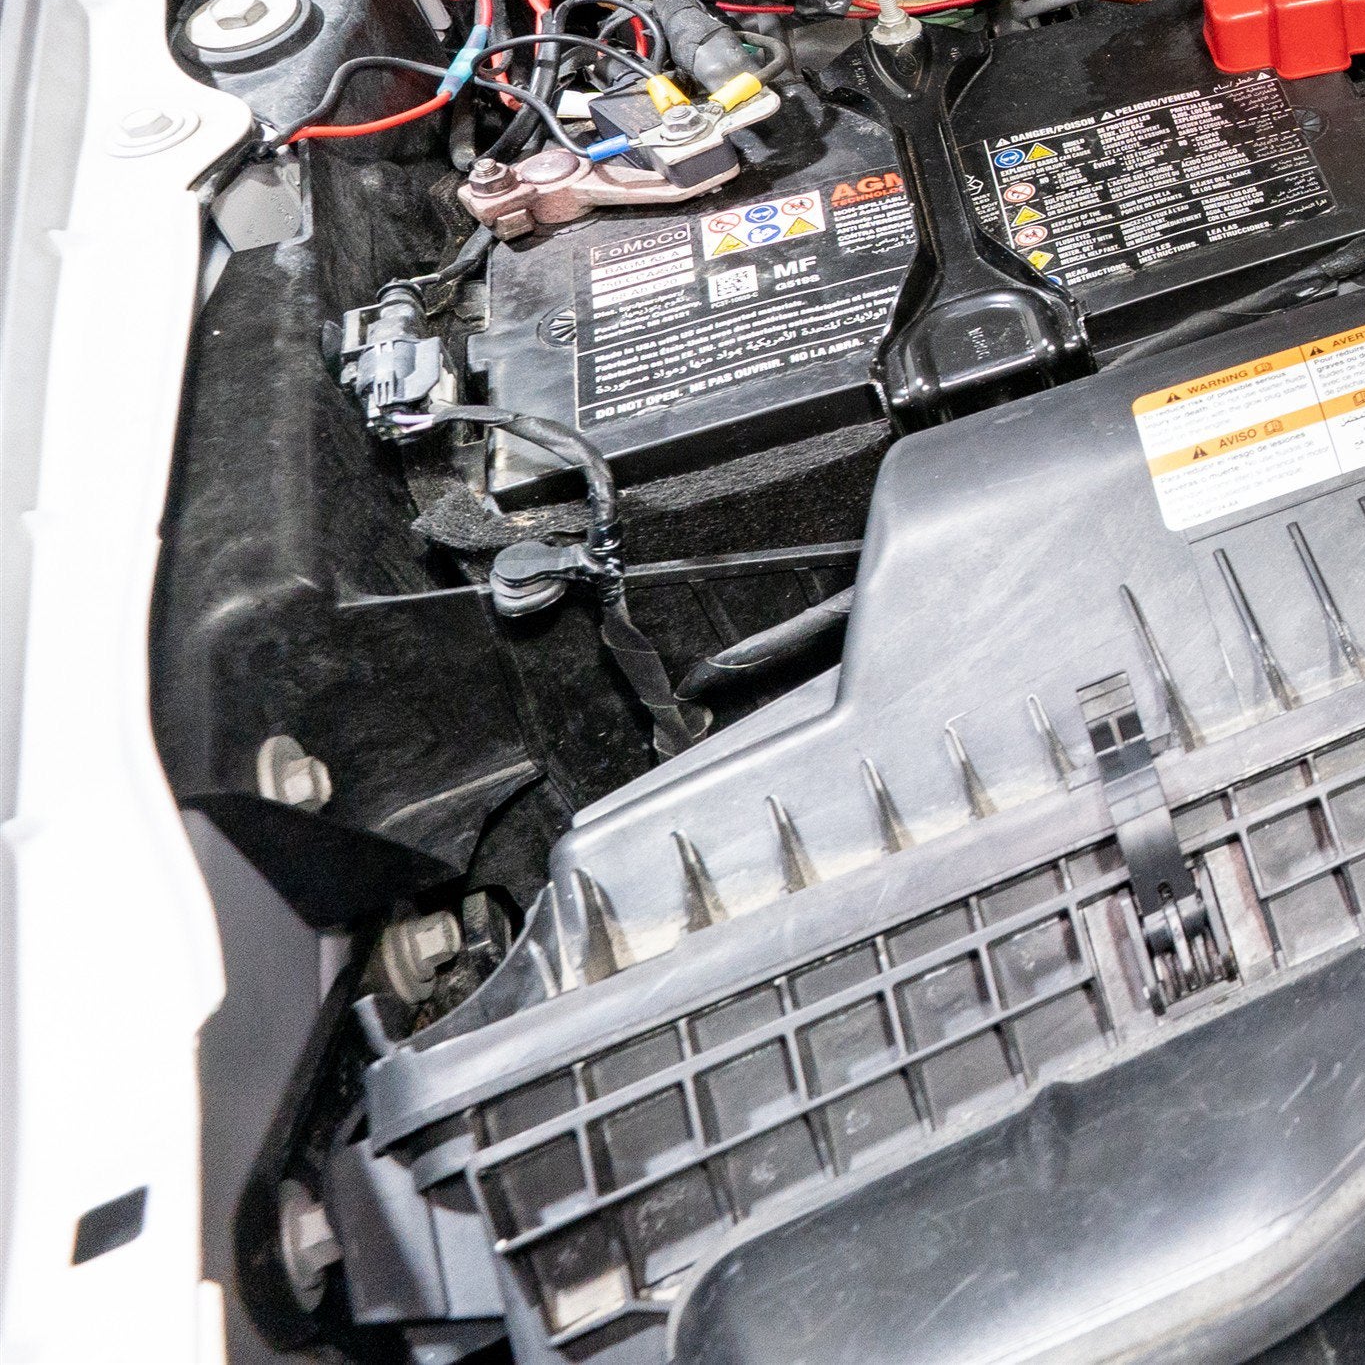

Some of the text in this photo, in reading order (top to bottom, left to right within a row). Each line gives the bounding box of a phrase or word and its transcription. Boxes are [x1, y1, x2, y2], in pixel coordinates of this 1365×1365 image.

[1010, 116, 1095, 144] DANGER/POISON
[1114, 89, 1200, 116] PELIGRO/VENENO
[1205, 223, 1238, 236] LEA LAS
[594, 226, 686, 262] FoMoCo
[773, 255, 818, 281] MF
[1064, 266, 1088, 278] READ
[594, 349, 622, 363] Made
[635, 339, 656, 352] USA
[595, 335, 864, 420] DO NOT OPEN. NE PAS OUVRIR. NO LA ABRA.
[1186, 368, 1248, 396] WARNING
[1217, 426, 1258, 449] AVISO
